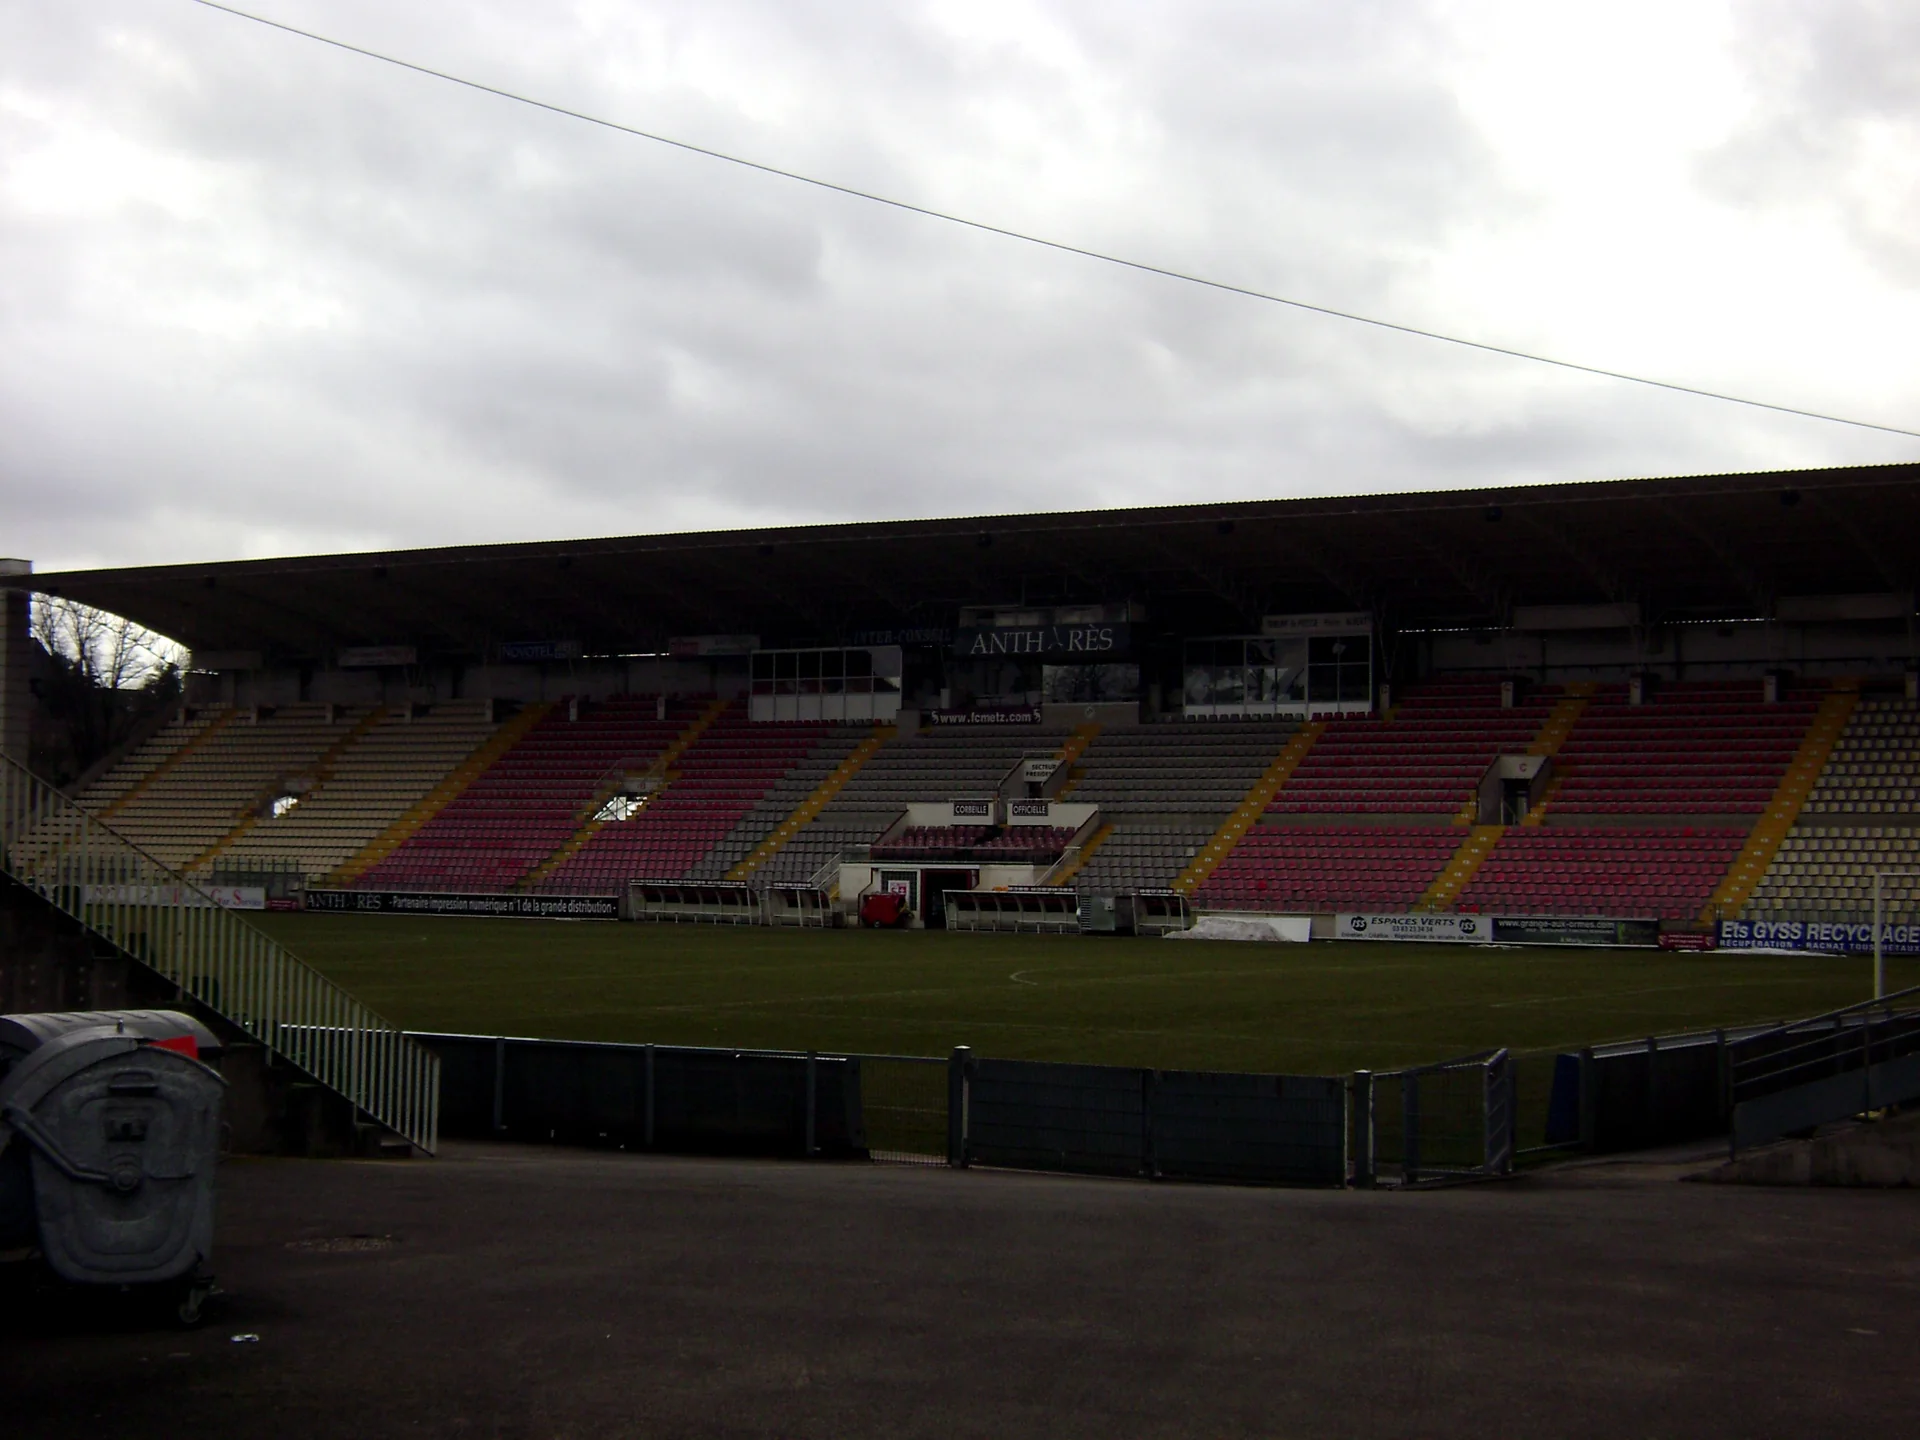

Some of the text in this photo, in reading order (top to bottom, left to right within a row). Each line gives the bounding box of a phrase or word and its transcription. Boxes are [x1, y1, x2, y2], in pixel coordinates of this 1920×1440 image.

[502, 645, 553, 659] NOVOTEL
[940, 711, 1032, 724] www.fcmetz.com
[955, 805, 987, 814] CORBEILLE
[1013, 805, 1046, 814] OFFICIELLE
[393, 895, 428, 909] Partenaire
[429, 896, 468, 912] impression
[469, 896, 507, 914] numérique
[522, 899, 532, 912] de
[533, 899, 540, 912] la
[541, 899, 566, 915] grande
[568, 899, 612, 914] distribution
[1371, 917, 1455, 926] ESPACES VERTS
[1721, 921, 1748, 938] Ets
[1753, 921, 1803, 940] GYSS
